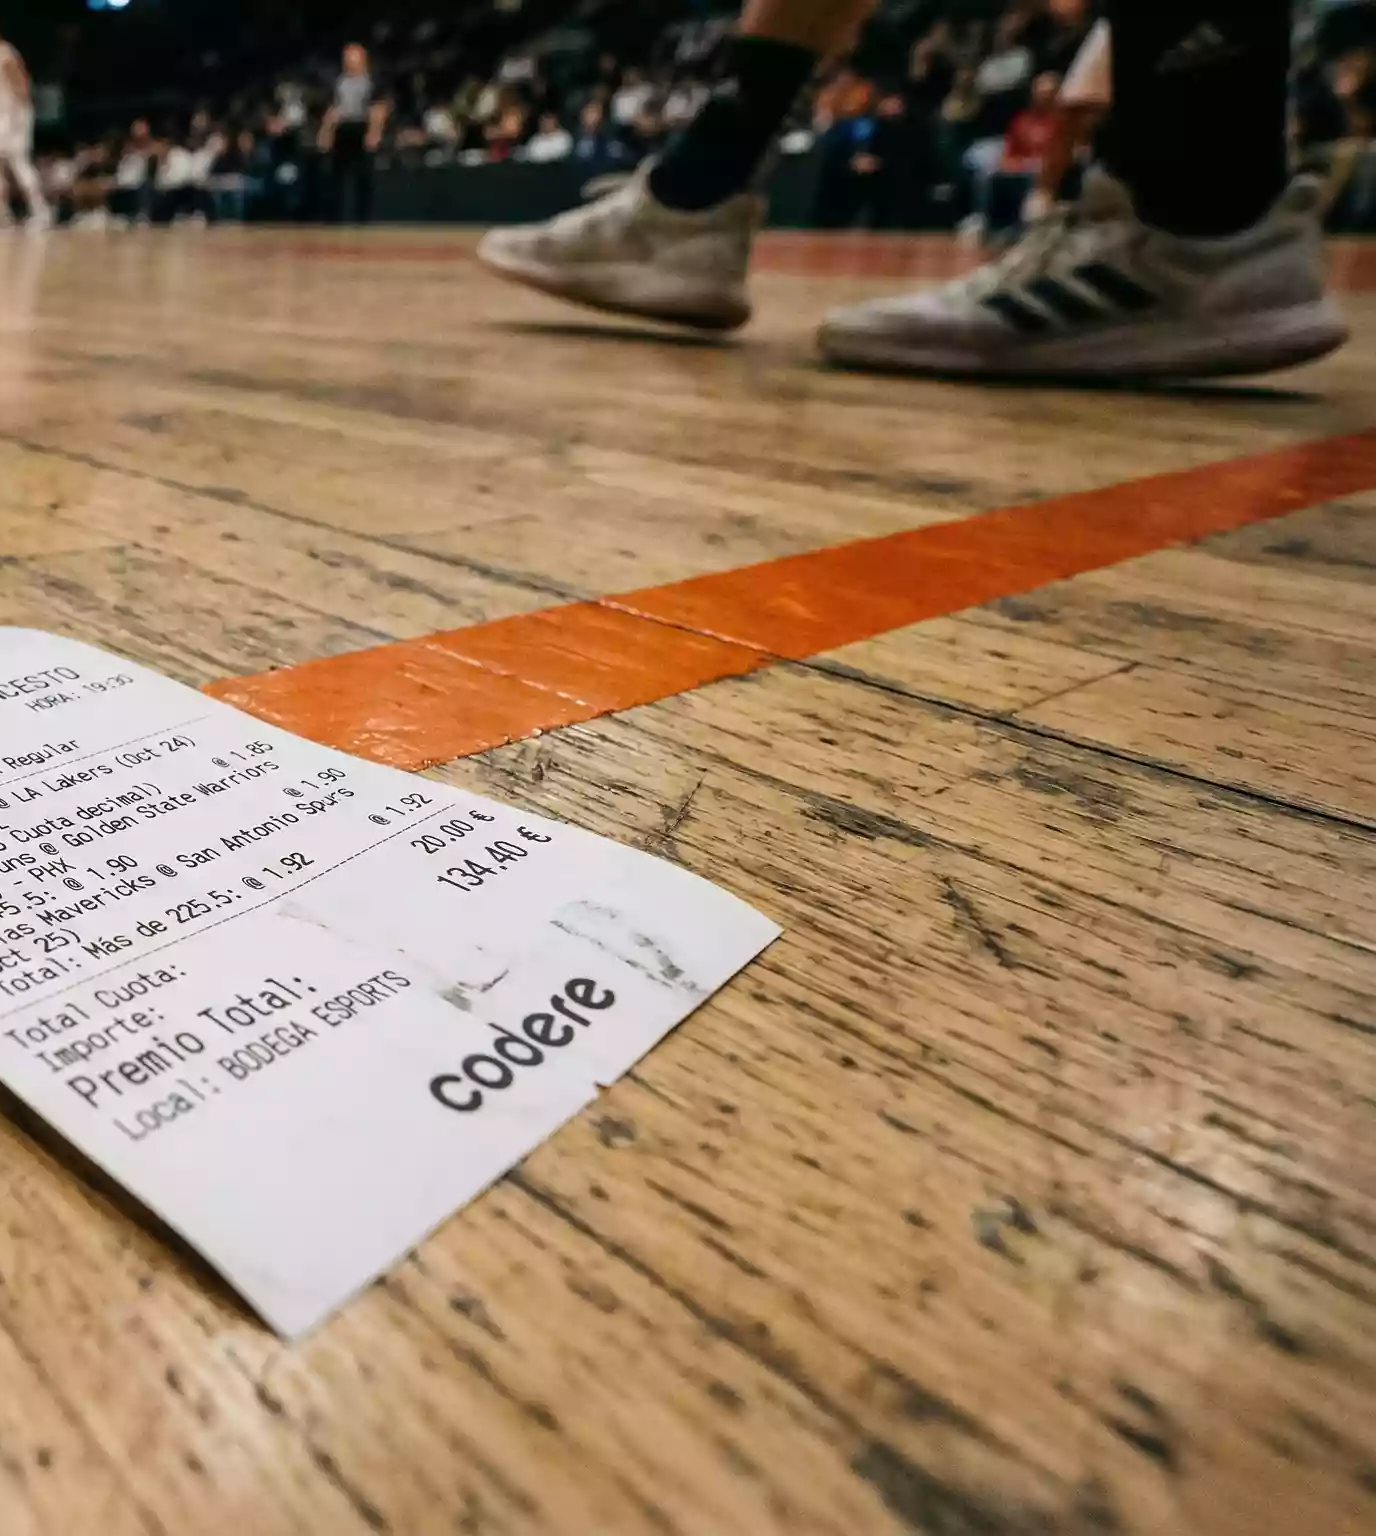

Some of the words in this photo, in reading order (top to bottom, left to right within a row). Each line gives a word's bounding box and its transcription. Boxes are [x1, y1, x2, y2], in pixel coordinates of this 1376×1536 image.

[24, 692, 81, 712] HORA:
[1, 739, 80, 770] Regular
[10, 787, 44, 803] LA
[41, 765, 114, 793] Lakers
[115, 747, 162, 769] (Oct
[159, 736, 196, 753] 24)
[229, 740, 274, 761] 1.85
[61, 815, 140, 848] Golden
[135, 793, 197, 819] State
[191, 761, 280, 797] Warriors
[300, 767, 347, 789] 1.90
[385, 793, 434, 816] 1.92
[9, 816, 76, 843] Cuota
[76, 782, 162, 821] decimal)
[410, 819, 475, 855] 20.00
[468, 809, 495, 822] €
[516, 825, 553, 843] €
[27, 857, 77, 883] PHX
[35, 875, 157, 927] Mavericks
[175, 847, 222, 868] San
[219, 813, 300, 852] Antonio
[295, 788, 355, 815] Spurs
[86, 855, 138, 880] 1.90
[80, 935, 134, 960] Más
[136, 920, 168, 938] de
[164, 889, 242, 924] 225.5:
[261, 852, 315, 879] 1.92
[32, 927, 81, 954] 25)
[3, 1002, 91, 1049] Total
[93, 964, 187, 1009] Cuota:
[35, 1007, 165, 1073] Importe:
[66, 1032, 206, 1109] Premio
[196, 976, 317, 1034] Total:
[113, 1076, 221, 1142] Local:
[216, 1020, 319, 1081] BODEGA
[310, 970, 412, 1028] ESPORTS
[429, 977, 616, 1113] codere
